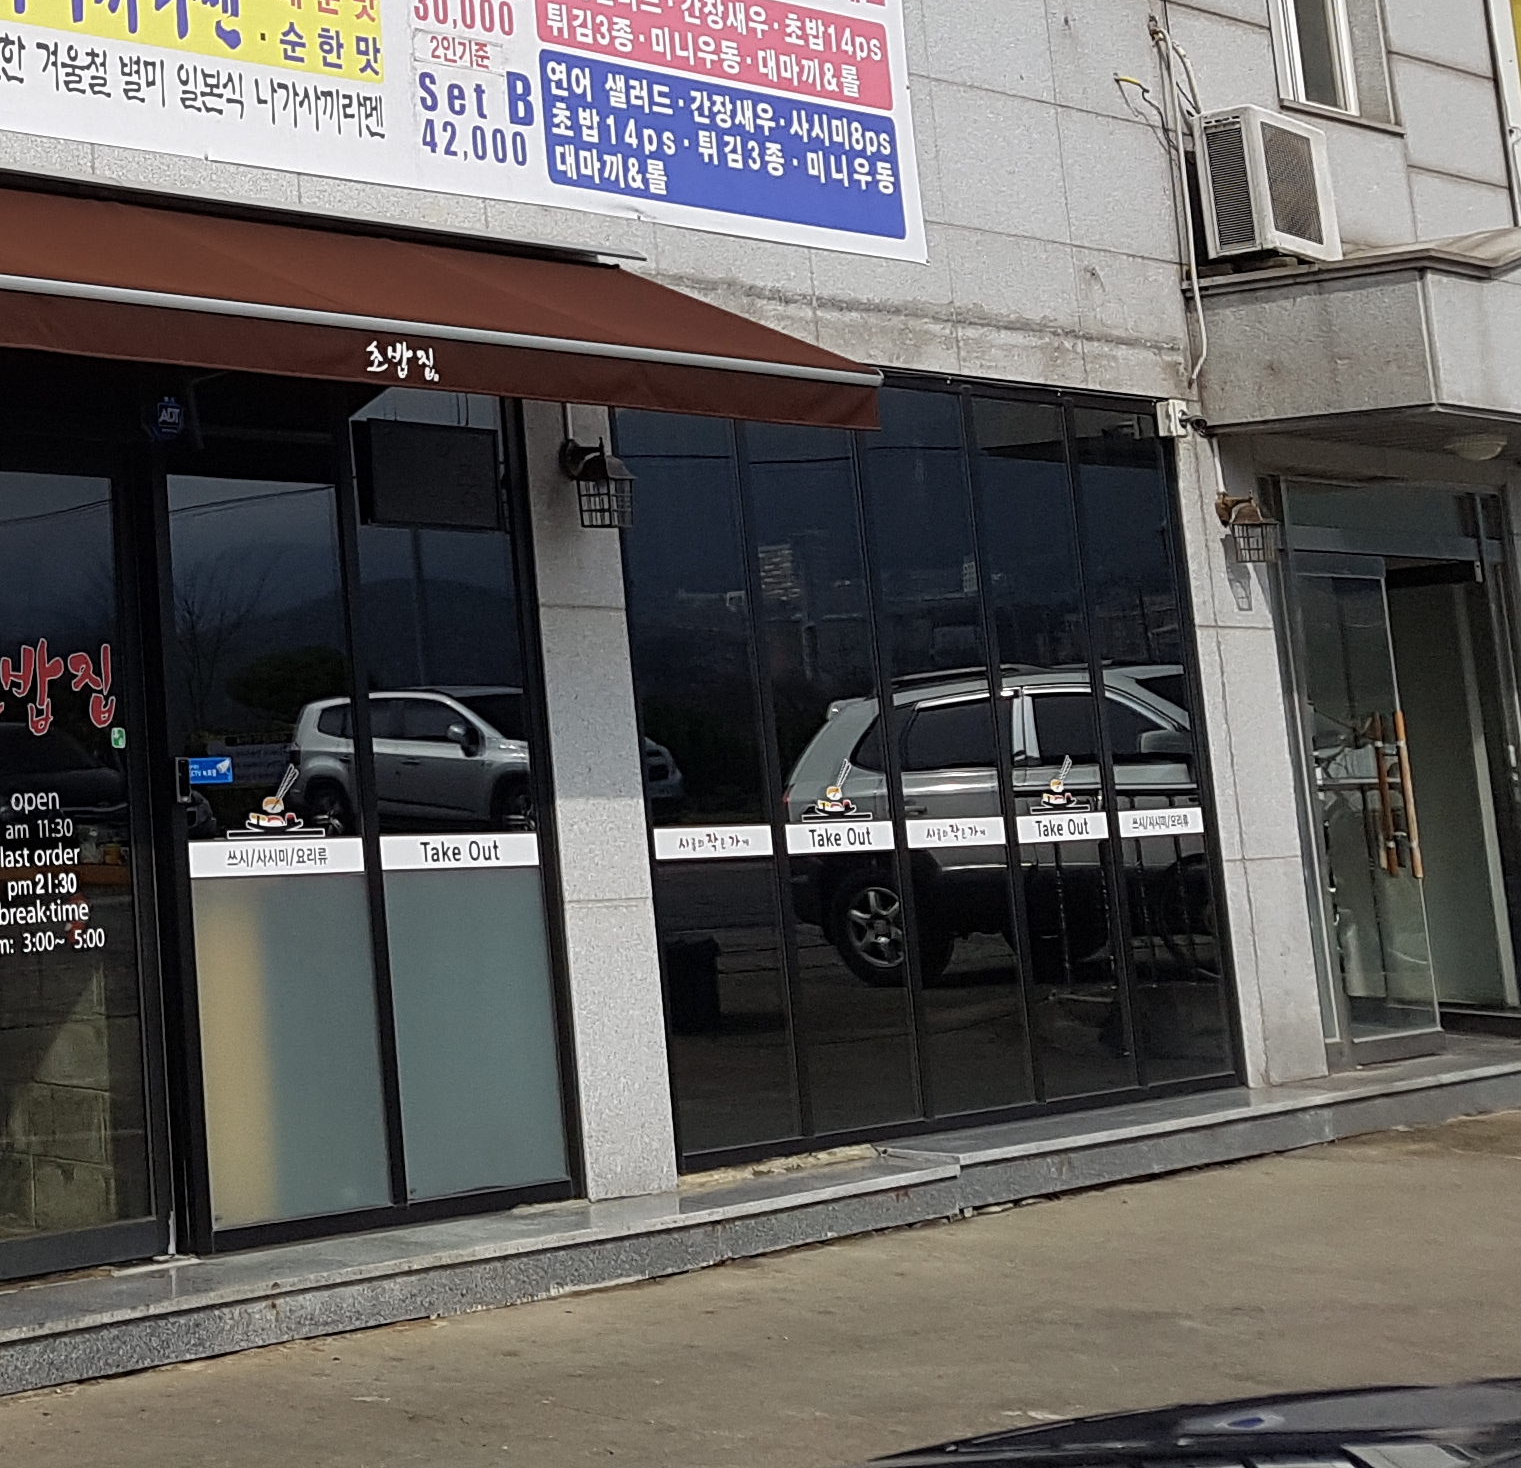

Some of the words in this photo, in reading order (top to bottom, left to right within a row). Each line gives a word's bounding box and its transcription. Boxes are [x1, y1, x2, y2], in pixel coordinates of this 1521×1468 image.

[429, 34, 491, 70] 2인기준
[36, 41, 112, 99] 겨울철
[119, 55, 166, 108] 별미
[176, 63, 245, 120] 일본식
[254, 76, 386, 140] 나가사끼라멘
[546, 60, 593, 102] 연어
[418, 71, 488, 120] Set
[506, 70, 535, 127] B
[421, 118, 528, 167] 42,000
[10, 792, 60, 815] open
[5, 825, 29, 840] am
[37, 818, 73, 838] 11:30
[809, 829, 841, 848] Take
[847, 827, 873, 846] Out
[1035, 819, 1064, 838] Take
[1068, 817, 1090, 836] Out
[0, 846, 30, 868] last
[34, 842, 80, 866] order
[420, 841, 462, 863] Take
[468, 839, 501, 862] Out
[7, 880, 32, 901] pm
[35, 873, 77, 895] 21:30
[74, 928, 105, 949] 5:00
